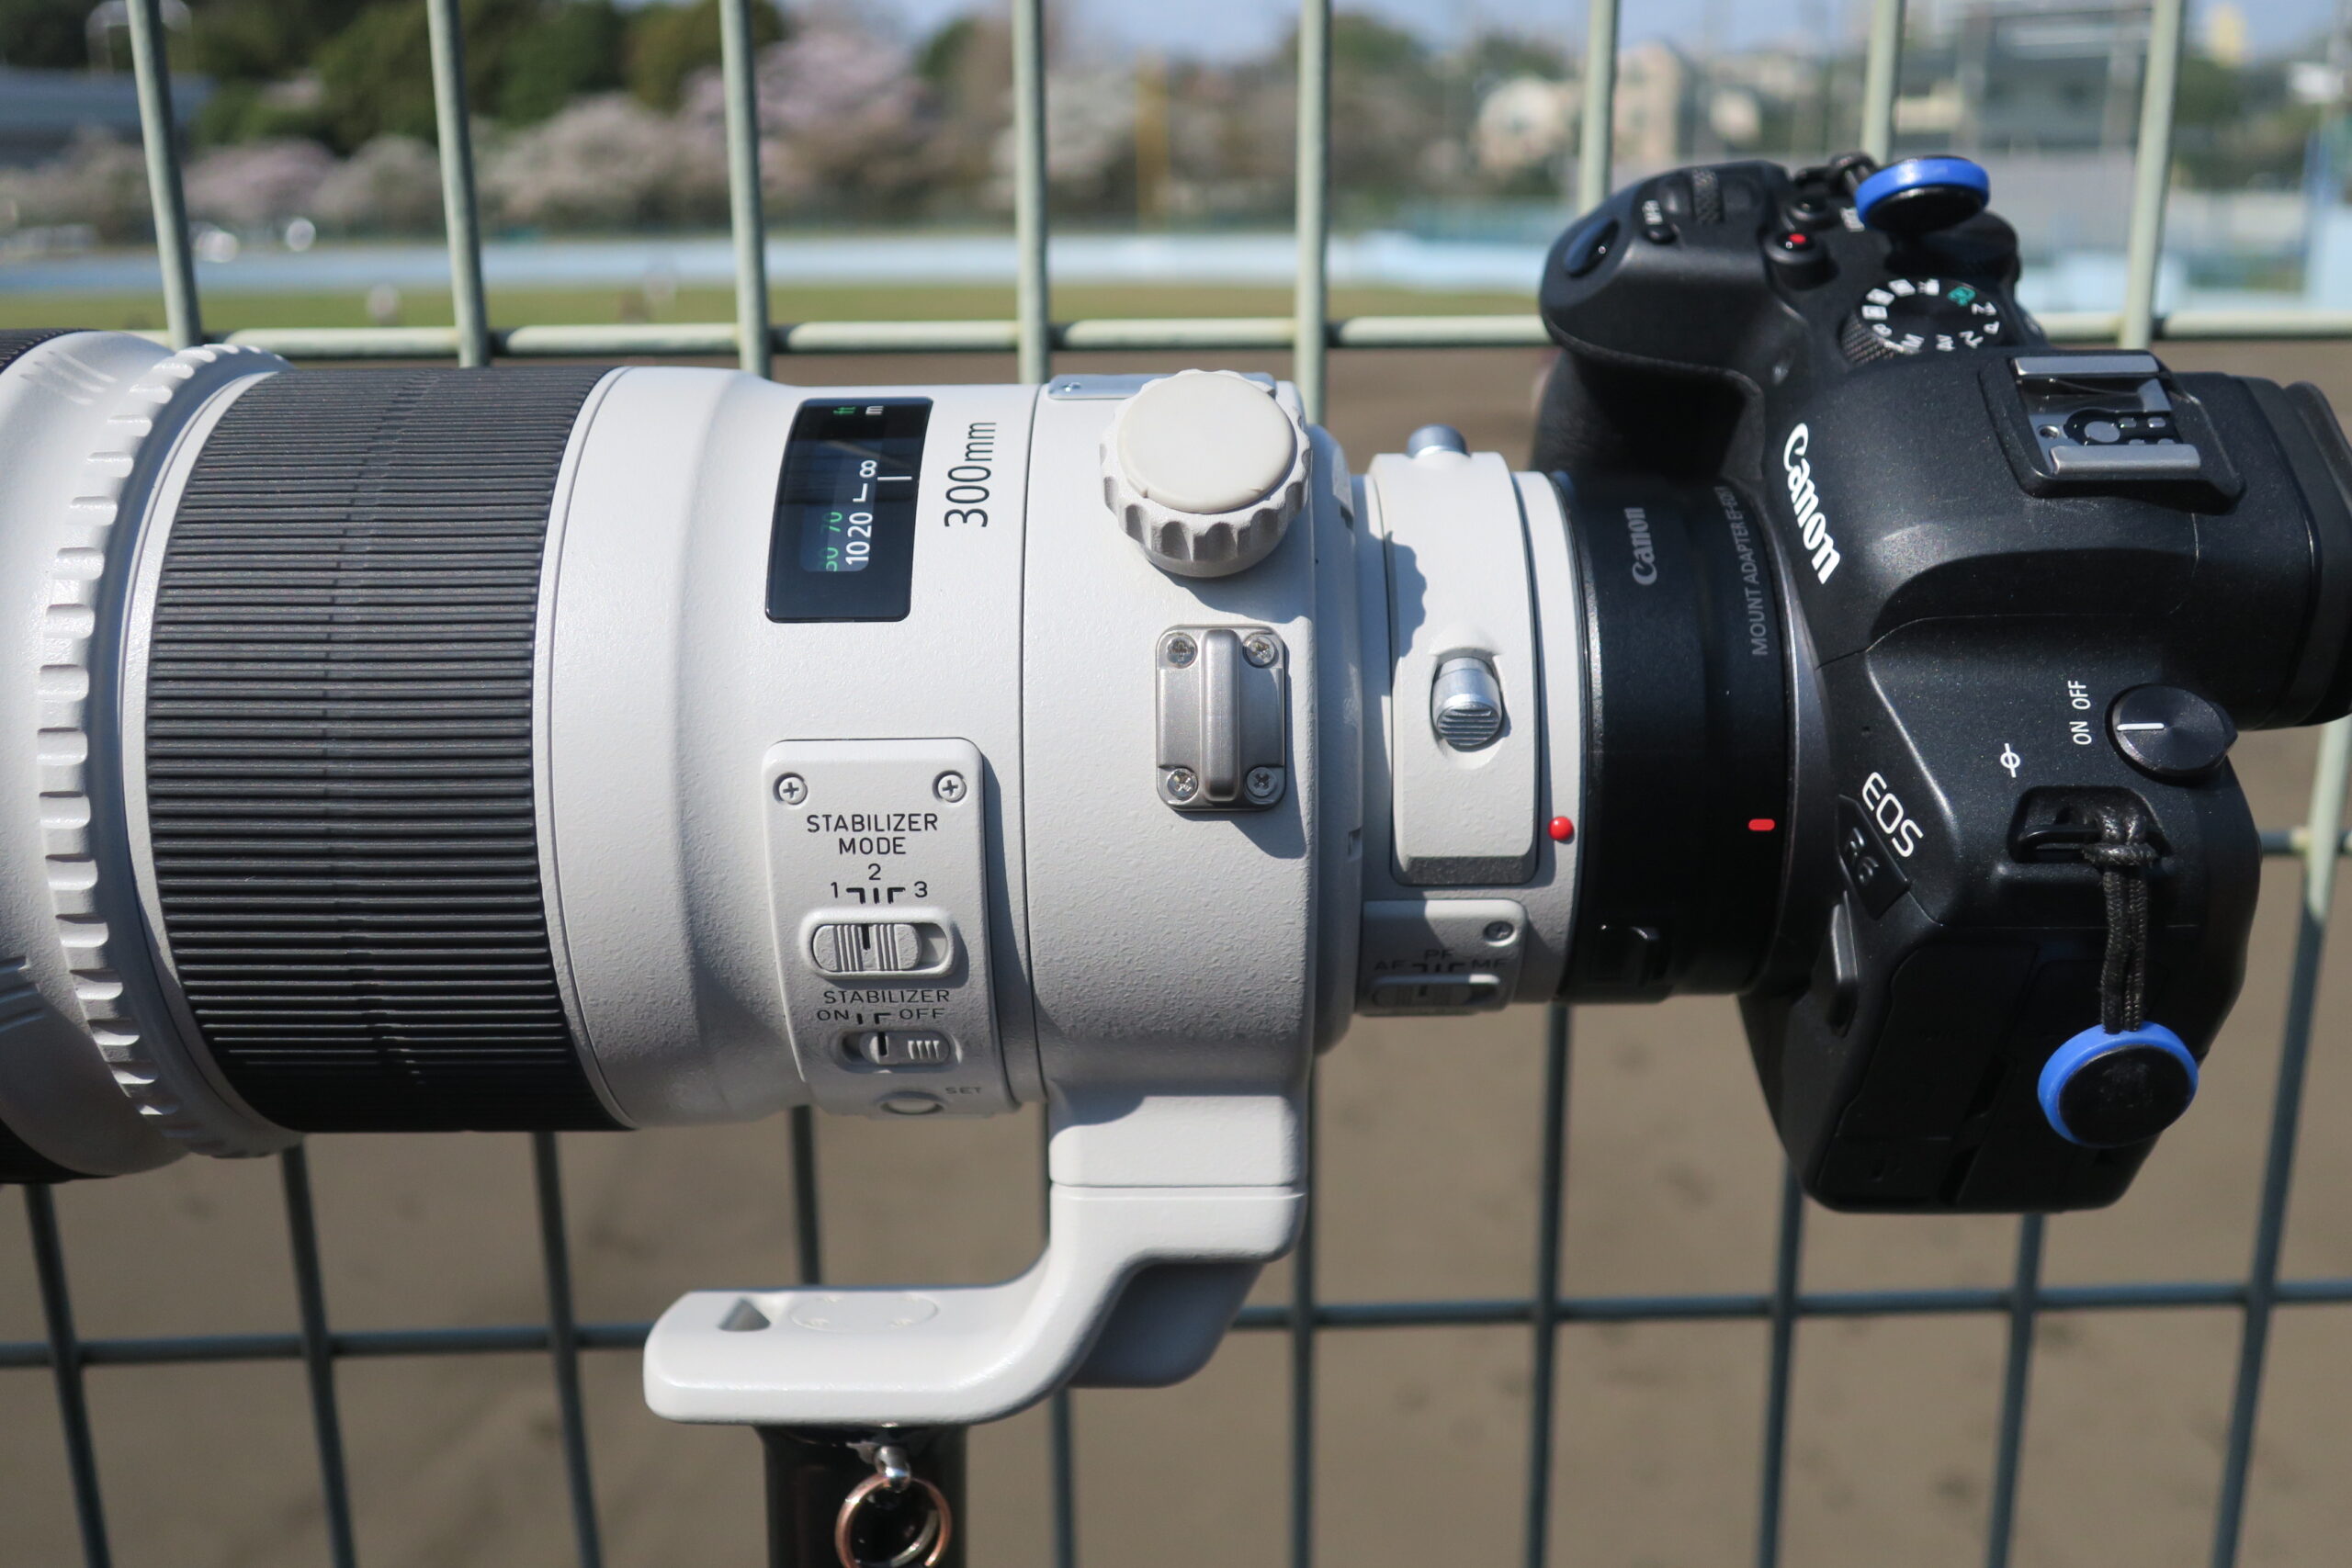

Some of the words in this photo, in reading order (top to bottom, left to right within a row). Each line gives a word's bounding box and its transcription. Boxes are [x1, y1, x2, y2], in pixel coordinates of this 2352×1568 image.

[944, 422, 997, 528] 300mm
[1783, 423, 1841, 584] Canon
[847, 512, 874, 537] 20
[845, 541, 871, 565] 10
[1623, 507, 1657, 585] Canon
[1730, 521, 1760, 586] ADAPTER
[1745, 587, 1768, 656] MOUNT
[2067, 680, 2090, 710] OFF
[2069, 720, 2092, 745] ON
[806, 813, 938, 832] STABILIZER
[1861, 772, 1924, 858] EOS
[839, 837, 907, 856] MODE
[867, 863, 882, 882] 2
[831, 881, 840, 898] 1
[914, 881, 929, 898] 3
[823, 989, 950, 1004] STABILIZER
[817, 1010, 850, 1022] ON
[899, 1008, 946, 1021] OFF
